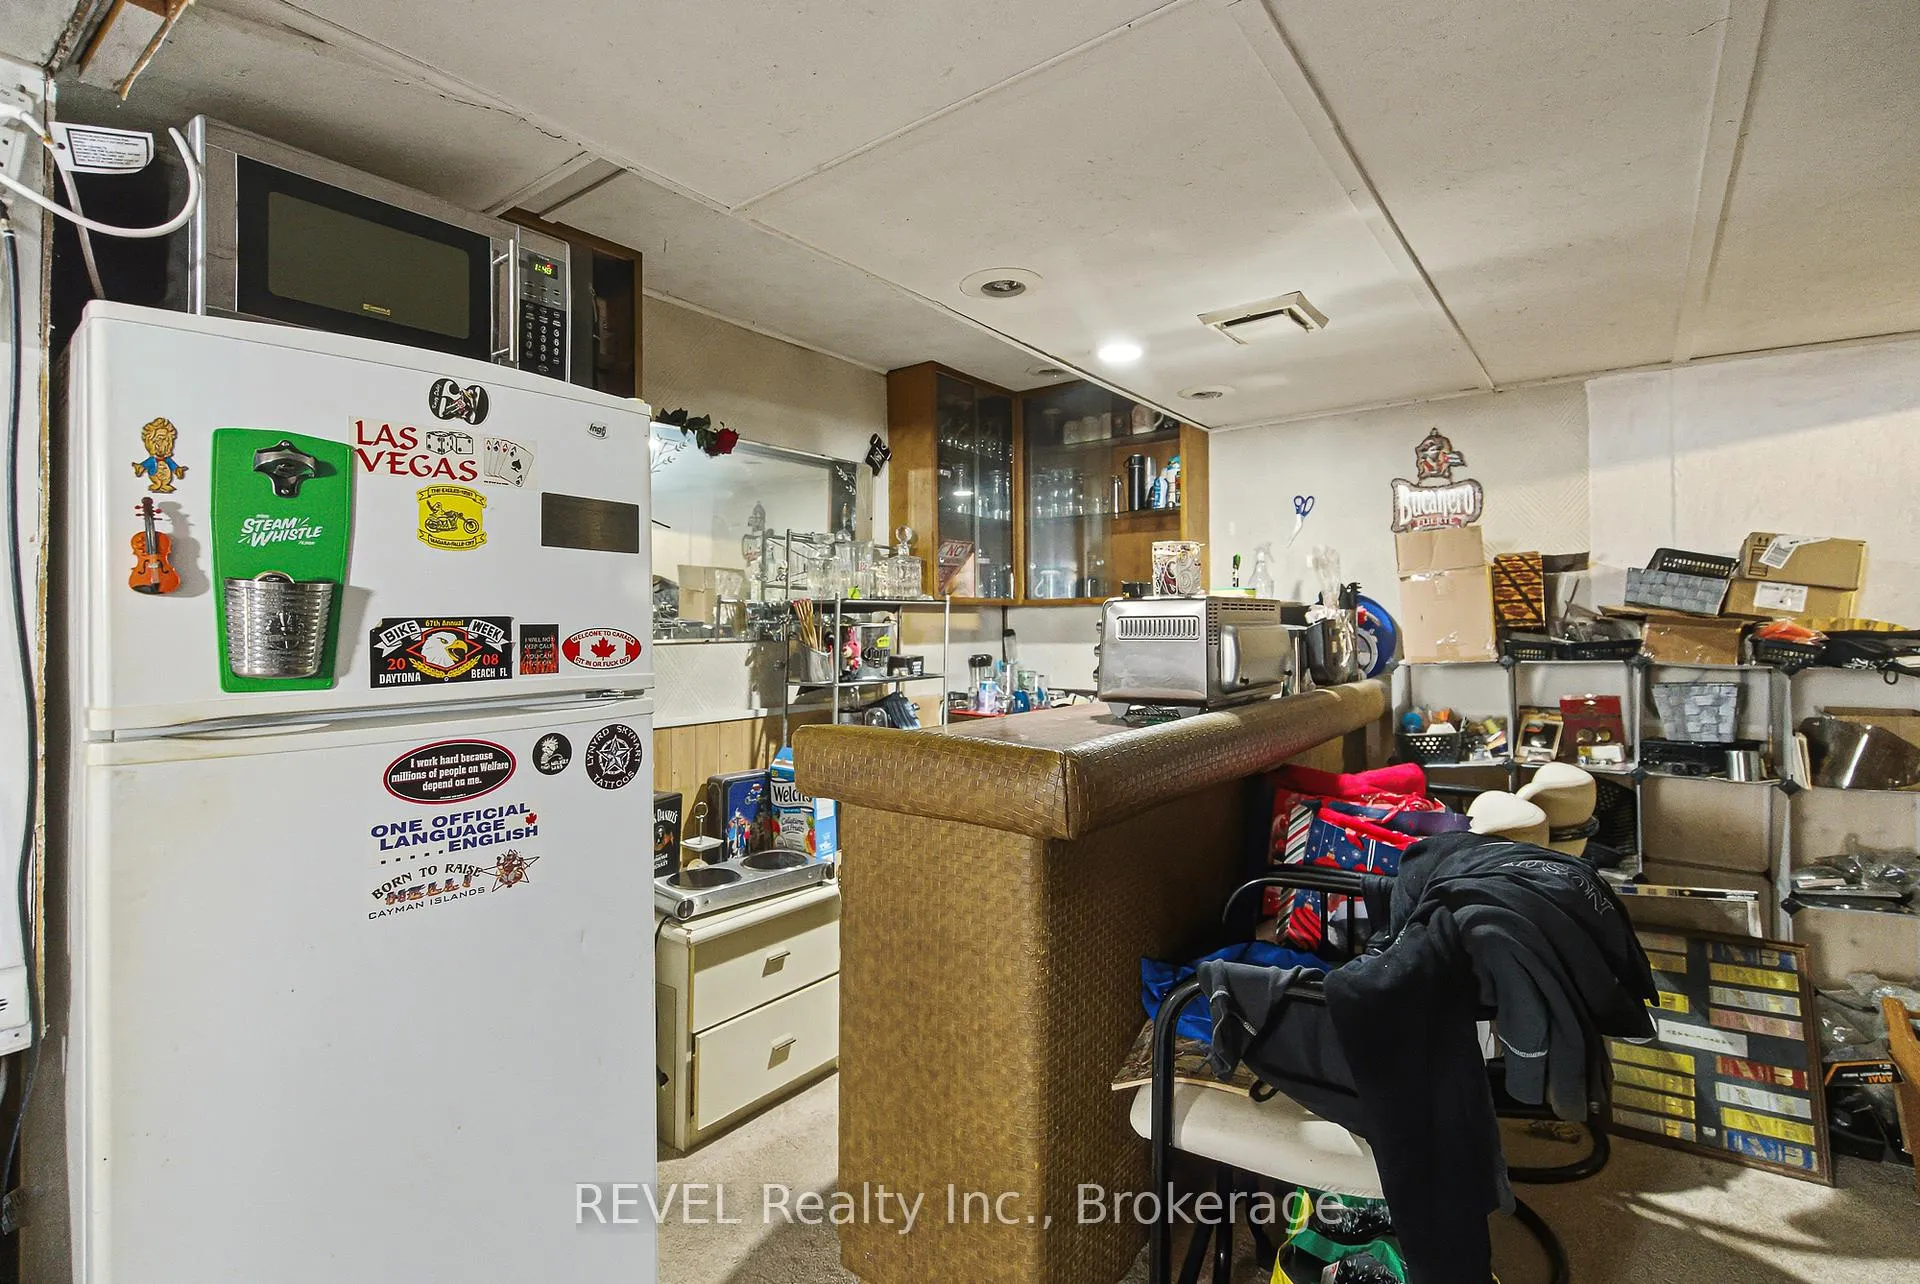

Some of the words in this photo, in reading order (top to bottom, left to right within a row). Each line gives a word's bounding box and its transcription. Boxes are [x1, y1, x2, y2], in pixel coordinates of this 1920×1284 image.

[355, 420, 418, 450] LAS
[354, 448, 478, 481] VEGAS
[1398, 484, 1475, 526] Bucanero
[241, 517, 298, 534] STEAM
[250, 526, 323, 547] WHISTLE
[384, 622, 418, 643] BIKE
[472, 620, 502, 640] WEEK
[612, 632, 634, 644] CANADA
[387, 658, 406, 670] 20
[482, 654, 498, 666] 08
[380, 672, 421, 684] DAYTONA
[471, 668, 496, 679] BEACH
[500, 667, 508, 677] FL
[587, 728, 610, 766] LYNYRD
[410, 759, 415, 768] I
[417, 757, 438, 767] work
[440, 754, 459, 765] hard
[461, 752, 493, 762] because
[391, 770, 426, 783] millions
[429, 768, 437, 778] of
[439, 765, 467, 777] people
[468, 764, 478, 773] on
[480, 761, 509, 772] Welfare
[593, 770, 635, 788] TATTOOS
[422, 778, 453, 792] depend
[455, 778, 464, 787] on
[467, 777, 482, 786] me.
[371, 819, 423, 838] ONE
[432, 803, 531, 828] OFFICIAL
[380, 819, 506, 851] LANGUAGE
[448, 825, 538, 852] ENGLISH
[371, 872, 412, 900] BORN
[419, 865, 438, 878] TO
[445, 864, 483, 878] RAISE
[368, 901, 424, 920] CAYMAN
[430, 886, 485, 906] ISLANDS
